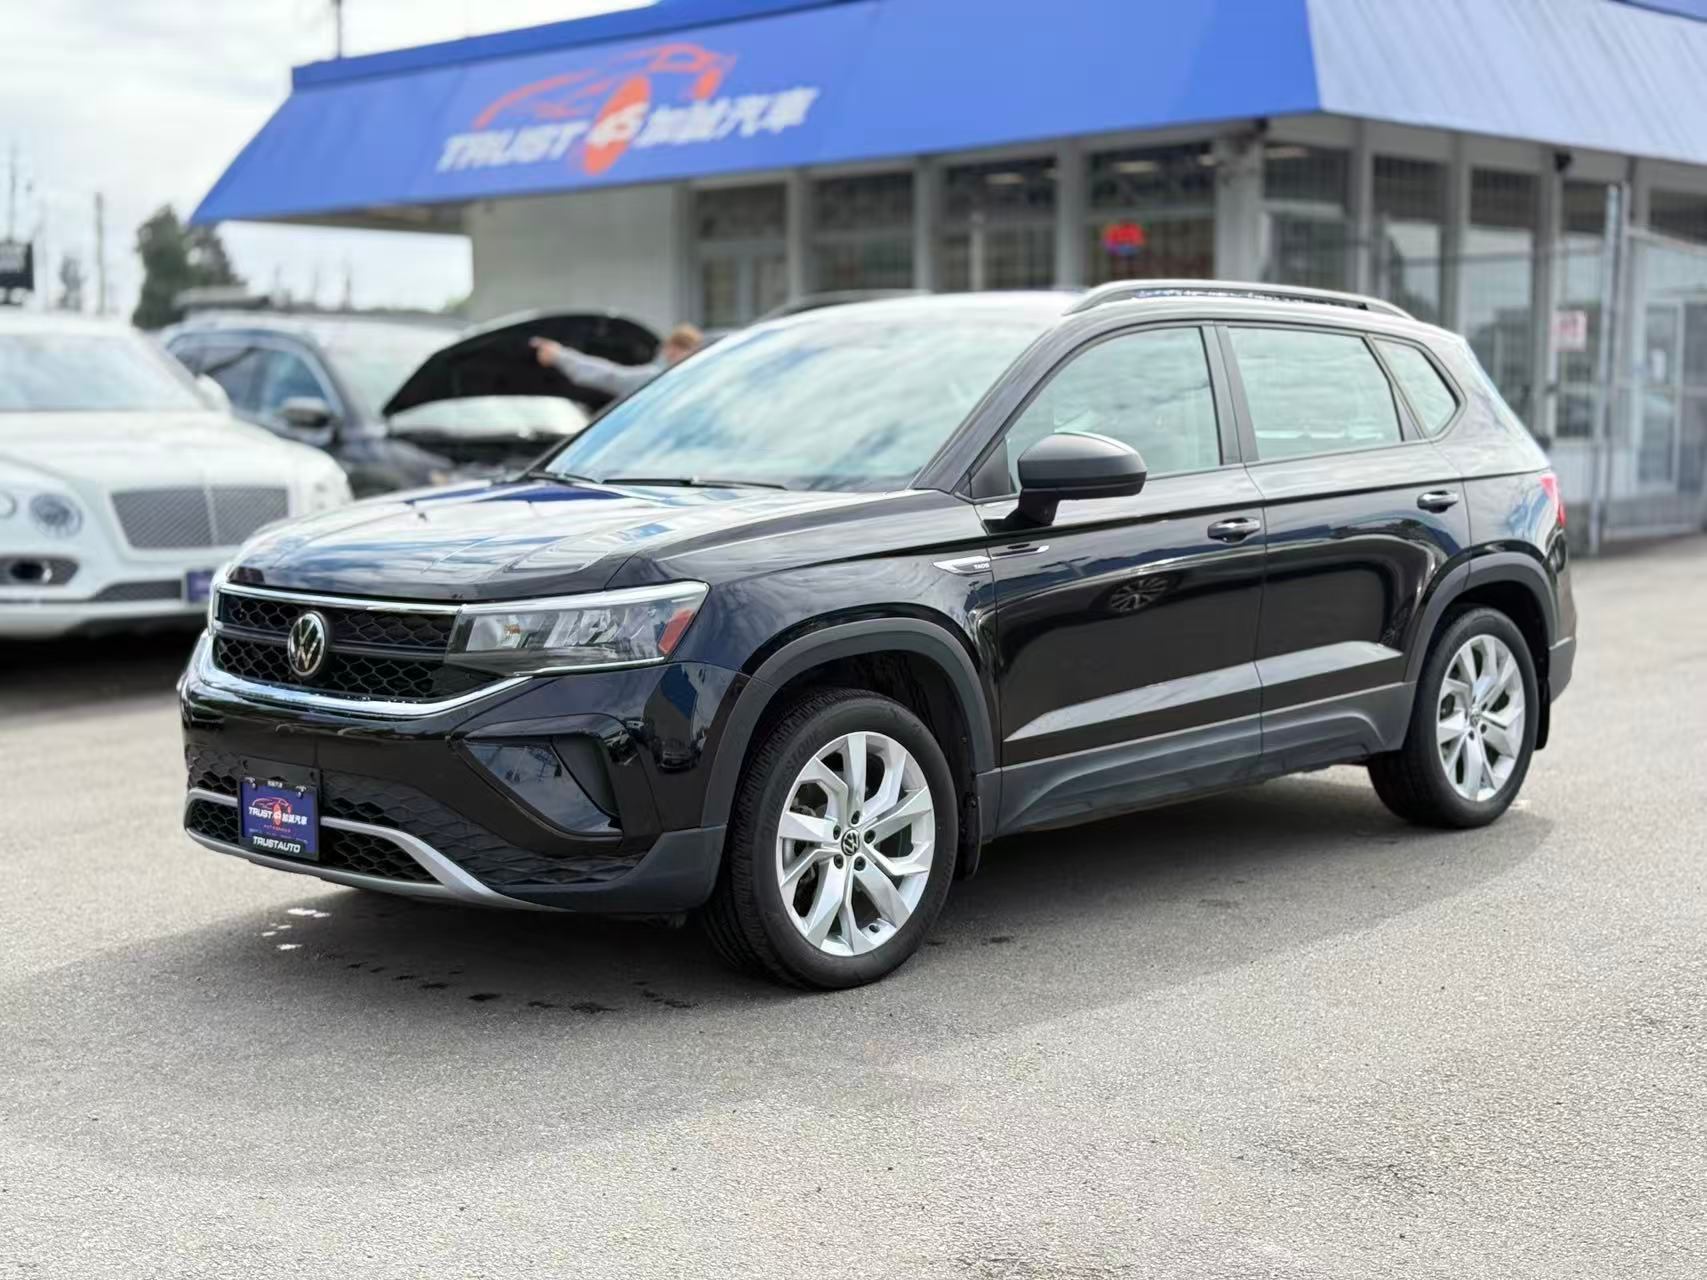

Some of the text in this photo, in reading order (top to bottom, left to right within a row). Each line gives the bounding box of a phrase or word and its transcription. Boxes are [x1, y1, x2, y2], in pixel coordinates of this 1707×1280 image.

[437, 121, 590, 171] TRUST
[248, 806, 273, 819] TRUST
[253, 836, 301, 853] TRUSTAUTO
